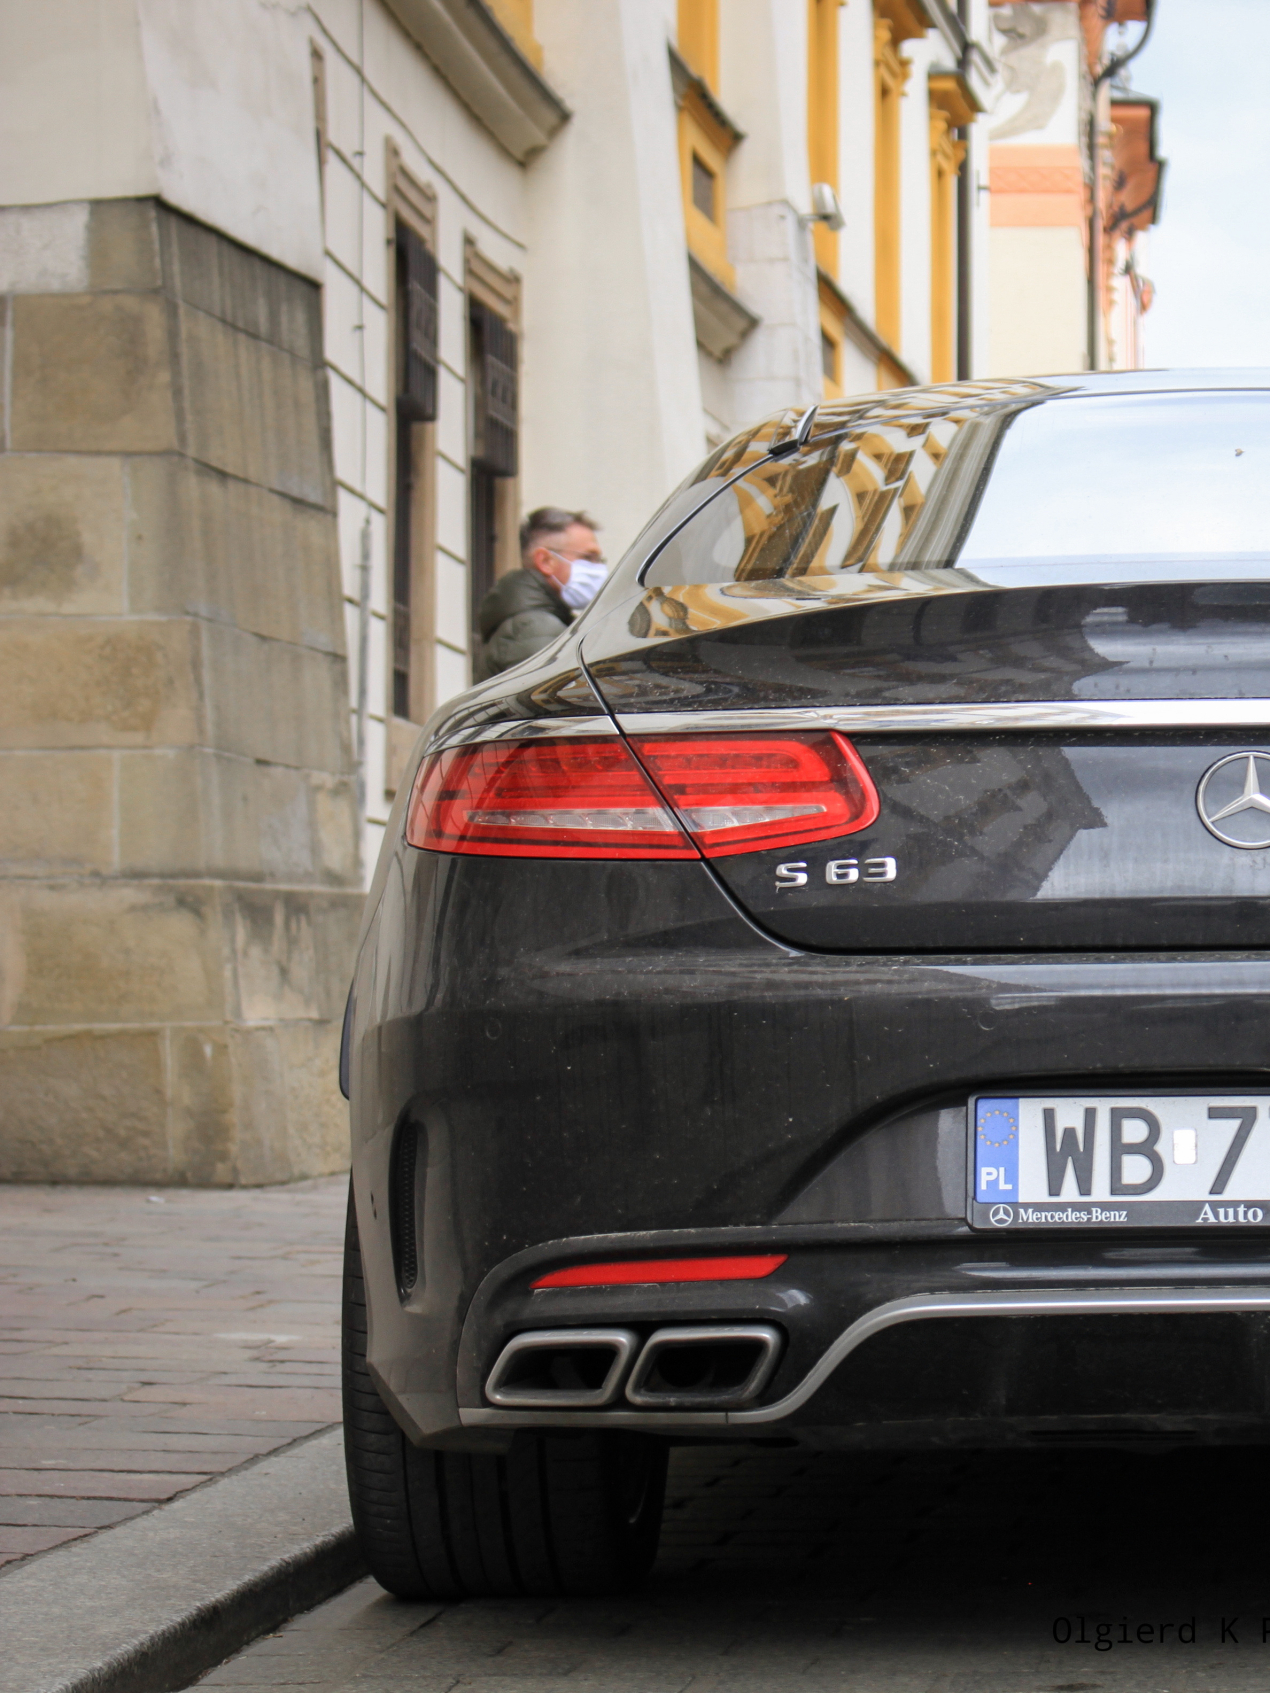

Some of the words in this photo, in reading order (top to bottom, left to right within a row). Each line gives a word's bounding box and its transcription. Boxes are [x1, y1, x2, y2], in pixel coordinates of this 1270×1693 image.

[775, 862, 808, 888] S
[825, 857, 897, 885] 63
[1042, 1106, 1164, 1197] WB
[980, 1166, 1013, 1191] PL
[1017, 1208, 1128, 1224] Mercedes-Benz
[1196, 1204, 1263, 1224] Auto
